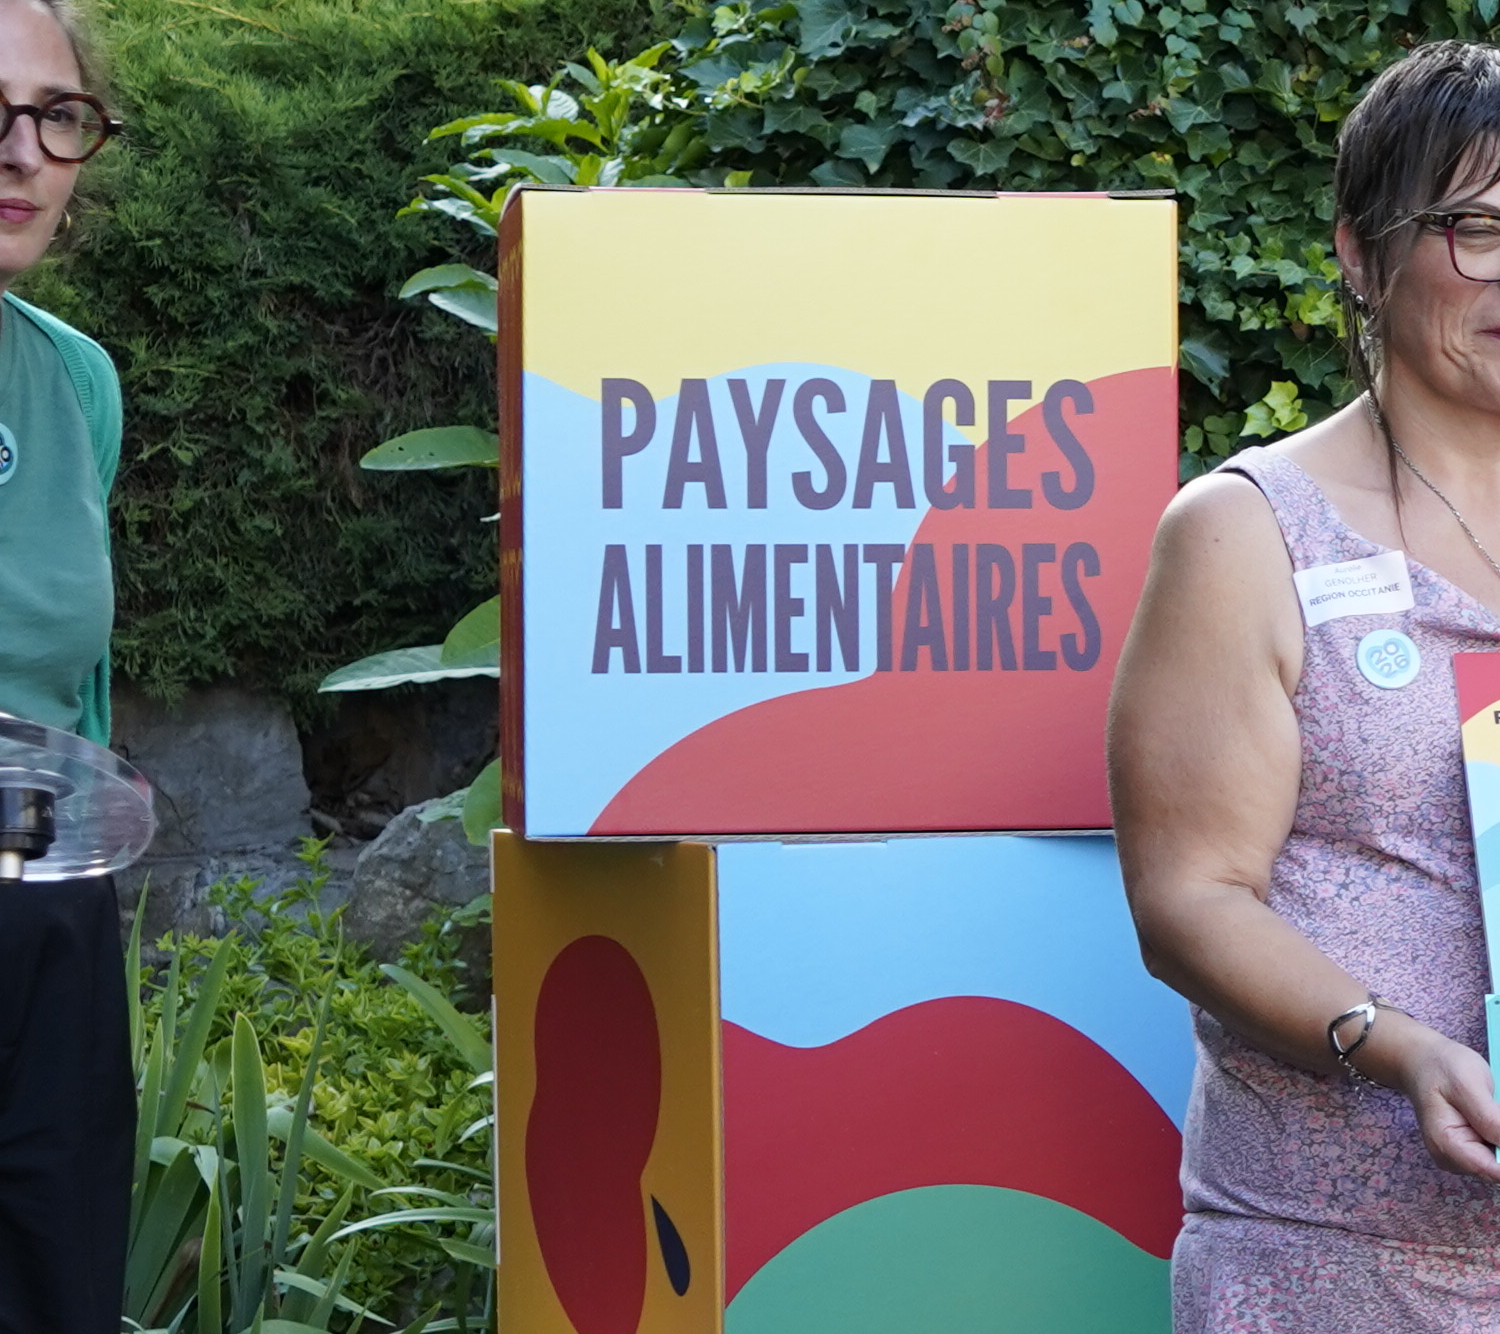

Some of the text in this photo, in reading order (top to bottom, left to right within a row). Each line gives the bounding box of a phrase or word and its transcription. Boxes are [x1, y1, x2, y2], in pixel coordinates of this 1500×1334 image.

[601, 378, 1095, 510] PAYSAGES
[591, 542, 1102, 674] ALIMENTAIRES
[1348, 582, 1400, 597] OCCITANIE
